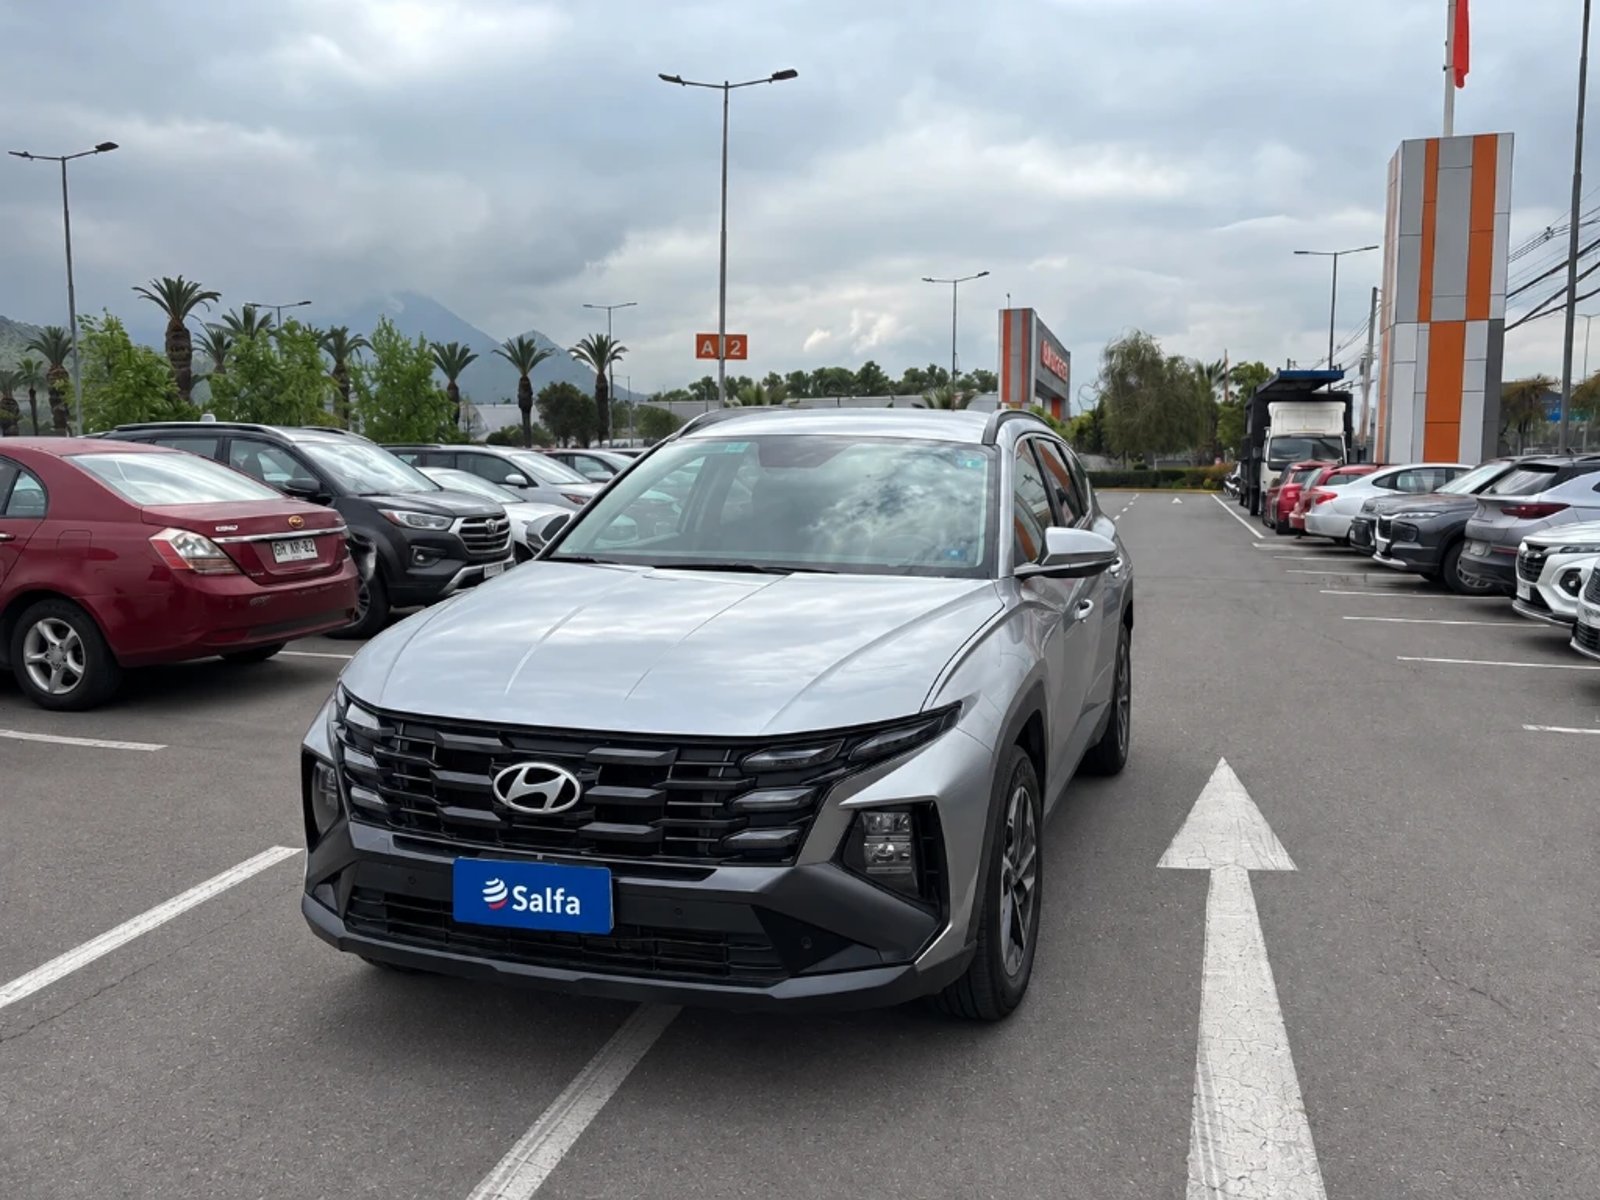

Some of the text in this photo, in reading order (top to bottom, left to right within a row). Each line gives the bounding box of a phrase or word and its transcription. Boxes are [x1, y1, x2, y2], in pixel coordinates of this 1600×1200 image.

[701, 339, 741, 355] A 2
[511, 885, 581, 915] Salfa
